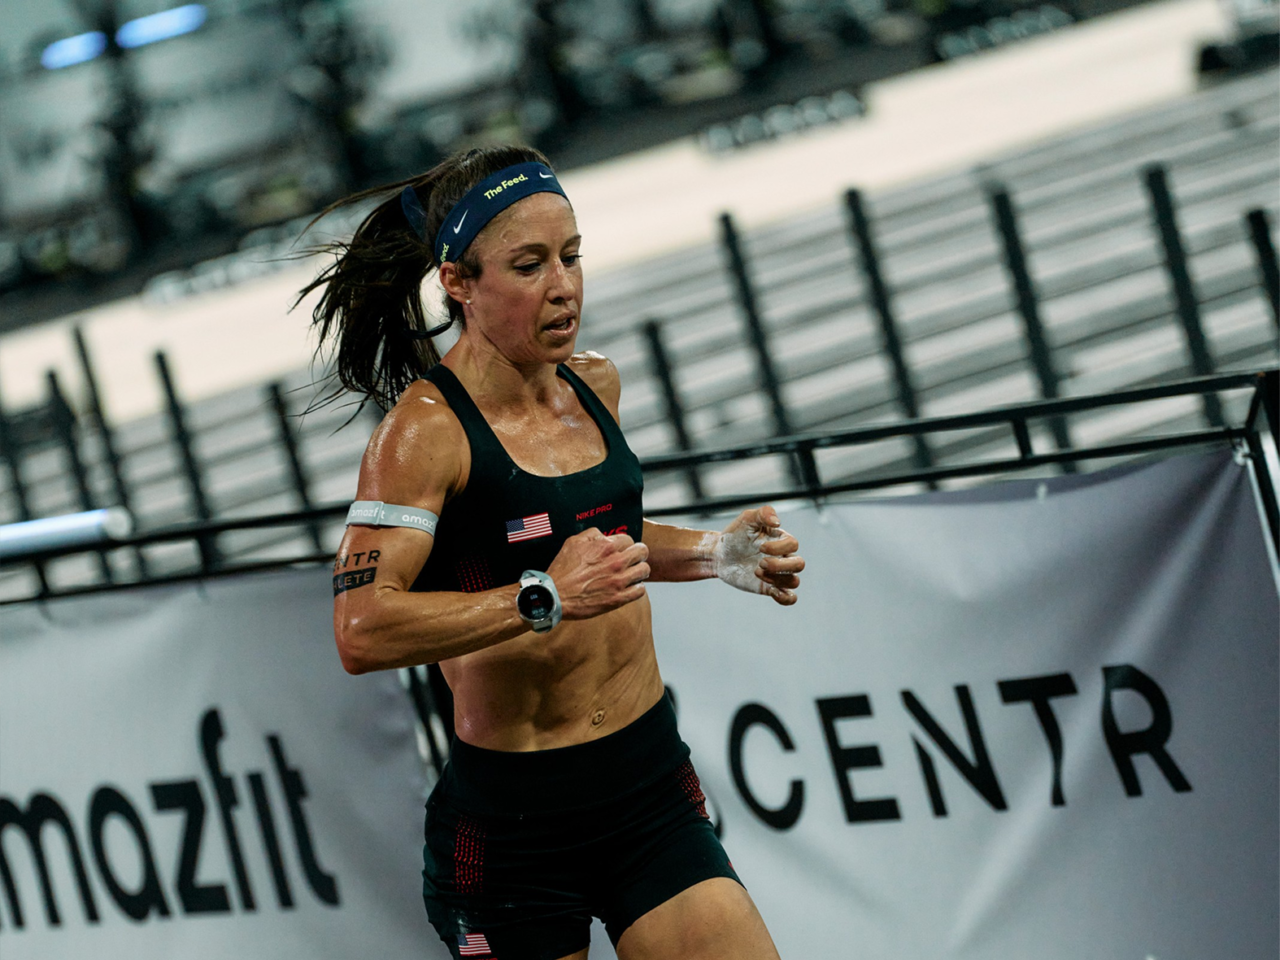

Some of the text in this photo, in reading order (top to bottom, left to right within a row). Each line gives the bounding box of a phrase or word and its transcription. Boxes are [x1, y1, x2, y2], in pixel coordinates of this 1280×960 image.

[483, 173, 529, 200] The Feed.
[402, 513, 437, 530] amaz
[576, 503, 613, 521] NIKE PRO
[727, 662, 1194, 833] CENTR
[0, 706, 342, 932] mazfit
